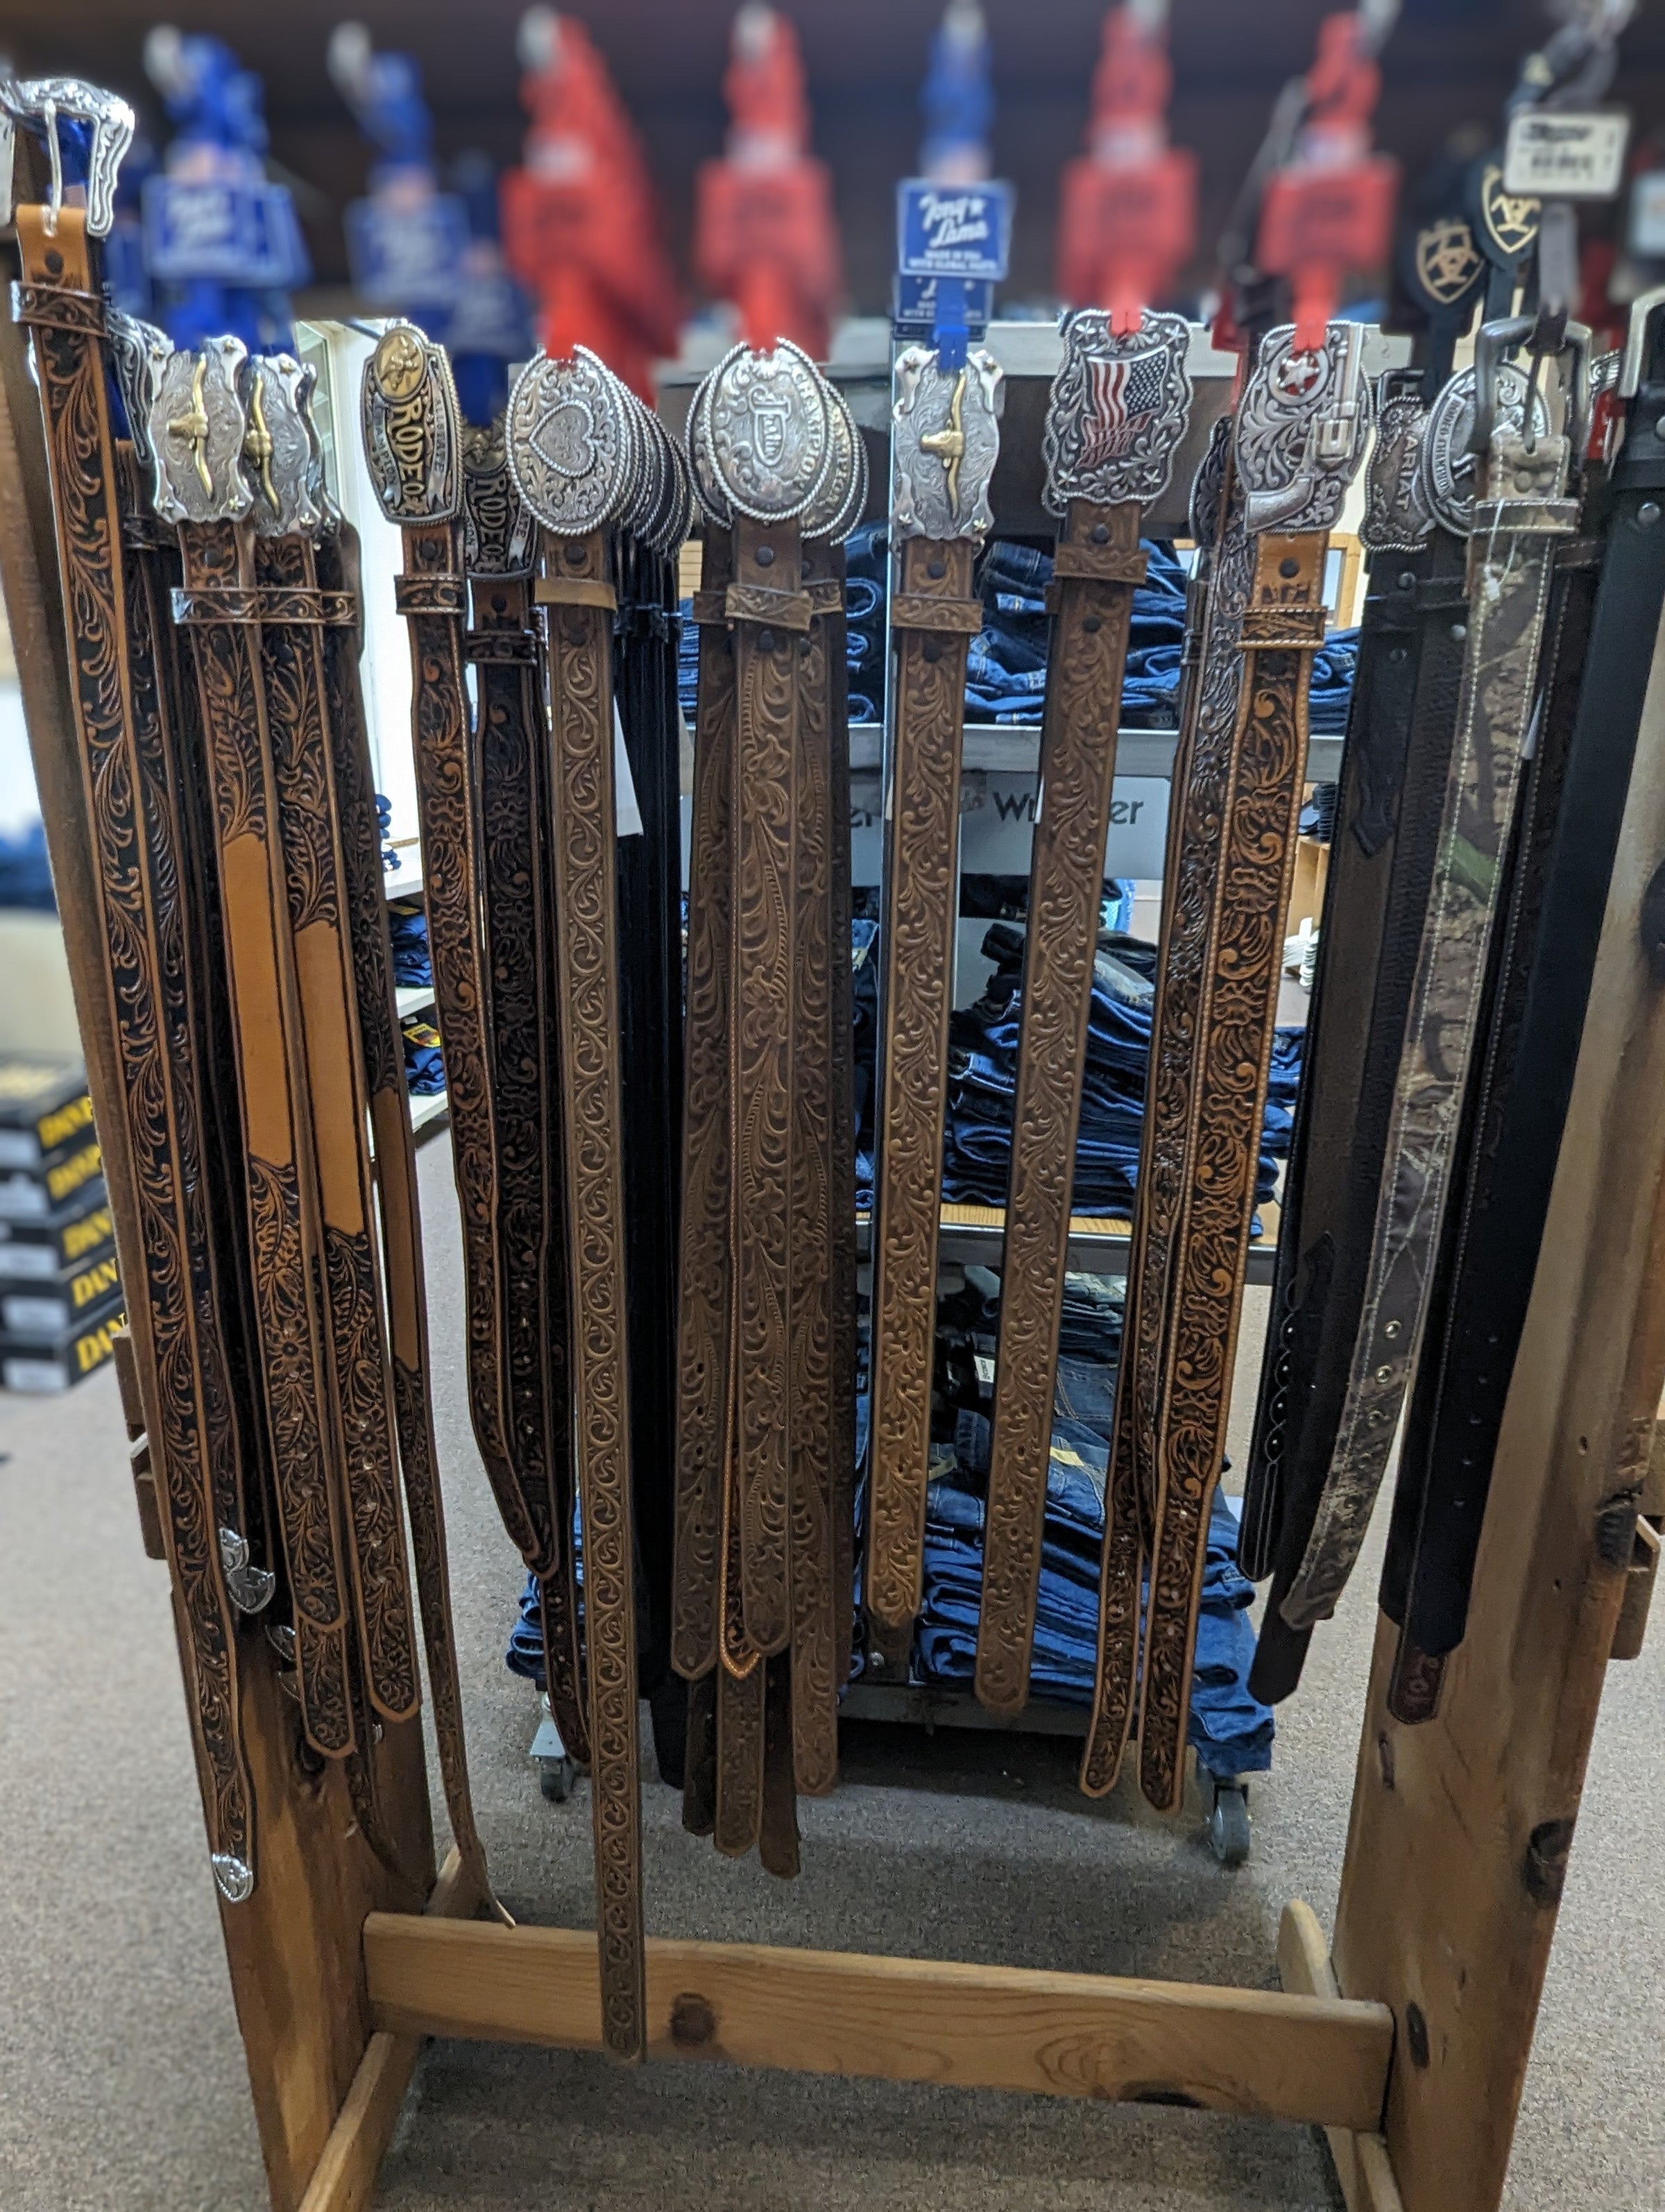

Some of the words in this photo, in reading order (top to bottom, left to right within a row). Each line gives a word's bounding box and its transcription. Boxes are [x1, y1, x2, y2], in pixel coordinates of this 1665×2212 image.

[389, 396, 423, 495] RODEO
[1396, 436, 1419, 510] ARIAT
[473, 473, 507, 554] RODEO
